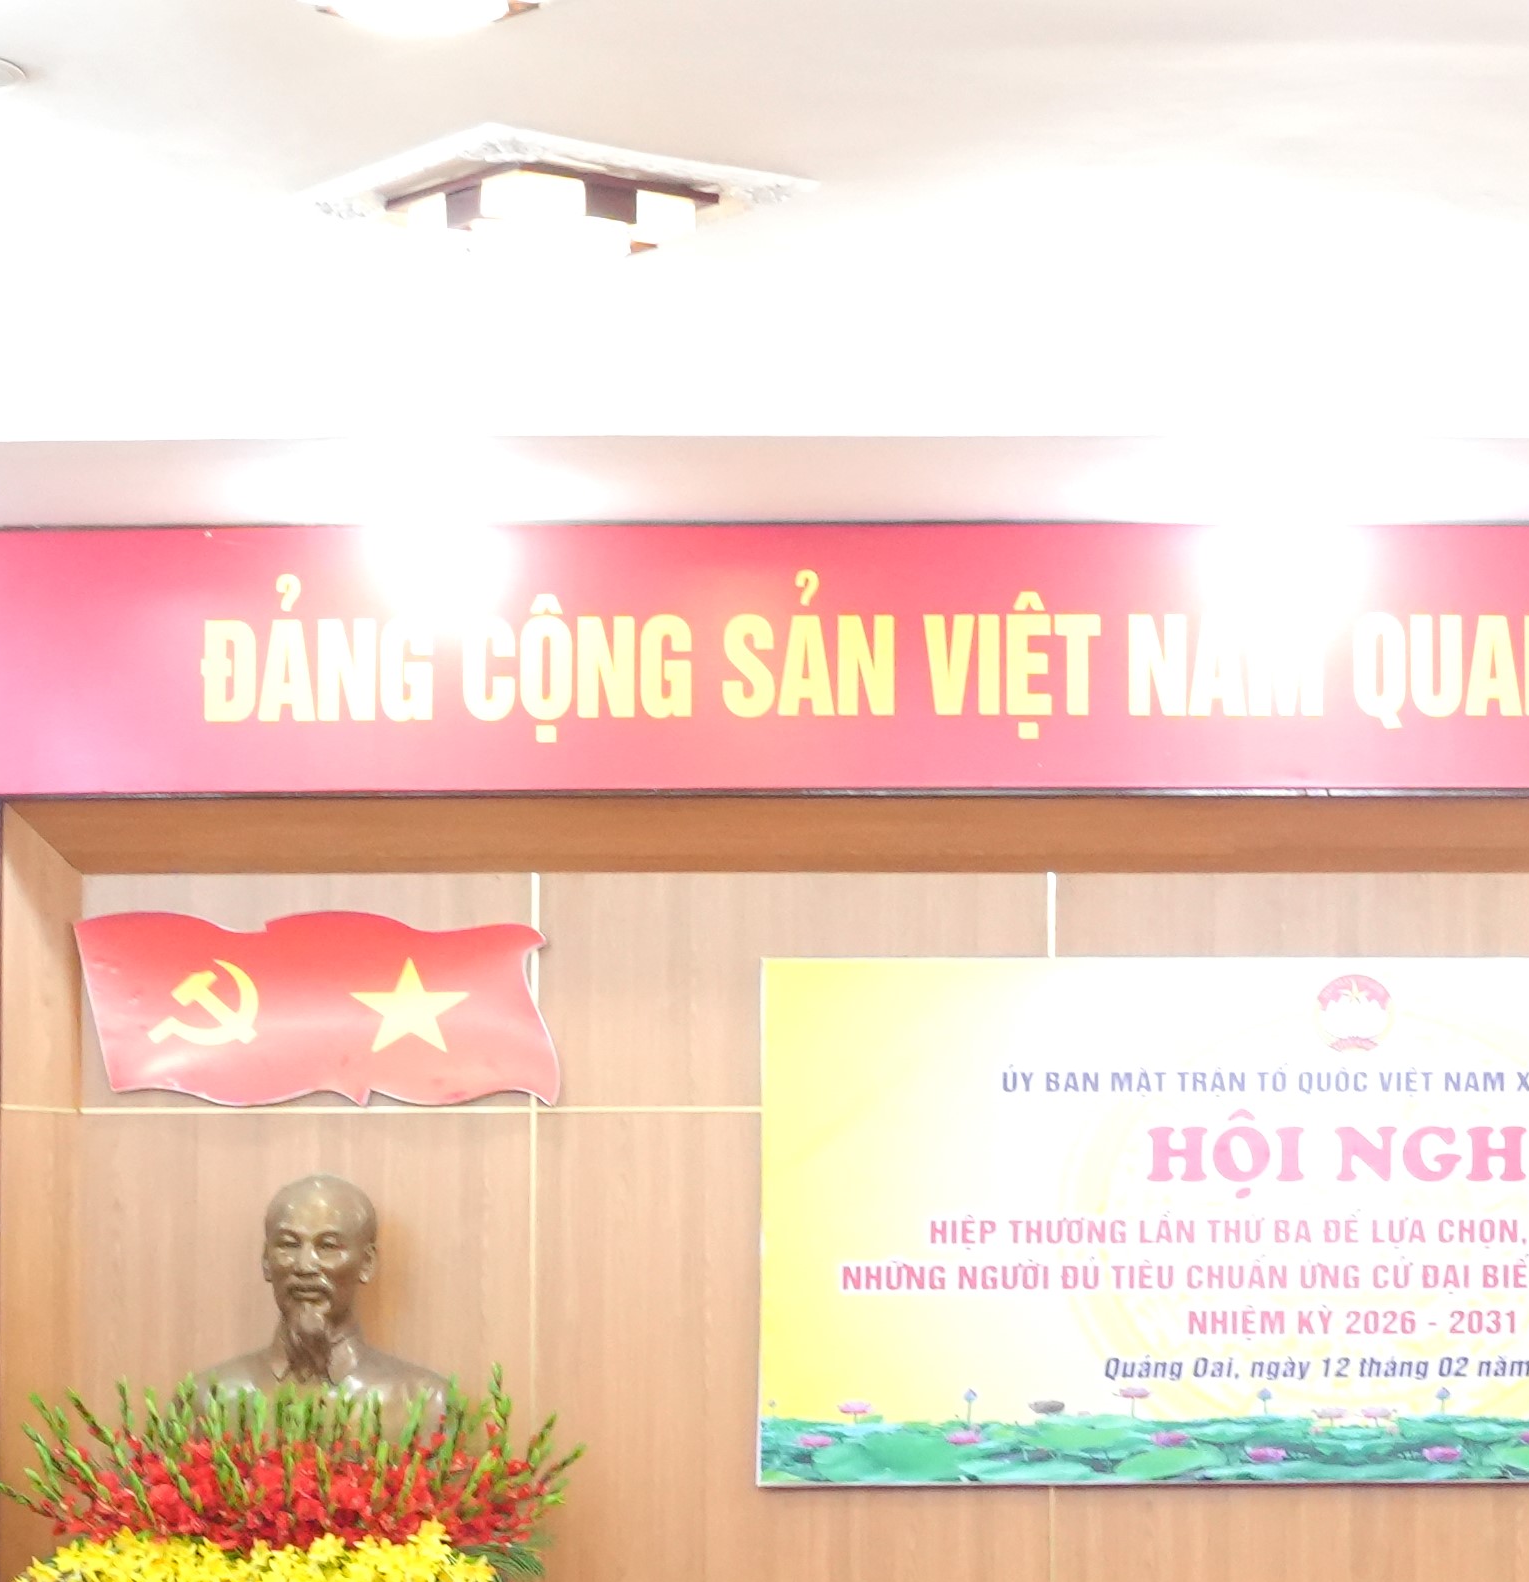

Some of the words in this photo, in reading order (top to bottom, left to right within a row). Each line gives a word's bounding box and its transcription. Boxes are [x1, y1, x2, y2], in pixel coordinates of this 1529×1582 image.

[202, 574, 434, 722] ĐẢNG
[462, 592, 692, 743] CỘNG
[722, 568, 896, 718] SẢN
[925, 590, 1102, 740] VIỆT
[1127, 612, 1325, 717] NAM
[1001, 1063, 1034, 1093] ỦY
[1045, 1071, 1100, 1093] BAN
[1256, 1062, 1288, 1093] TỔ
[1378, 1066, 1434, 1097] VIỆT
[1444, 1071, 1505, 1093] NAM
[1146, 1108, 1305, 1200] HỘI
[929, 1214, 997, 1251] HIỆP
[1008, 1216, 1127, 1245] THƯƠNG
[1138, 1210, 1196, 1244] LẦN
[1273, 1219, 1312, 1244] BA
[1322, 1208, 1361, 1244] ĐỂ
[1371, 1216, 1427, 1250] LỰA
[957, 1258, 1050, 1291] NGƯỜI
[1060, 1256, 1100, 1291] ĐỦ
[1372, 1255, 1414, 1290] CỬ
[1421, 1263, 1470, 1295] ĐẠI
[1187, 1304, 1286, 1341] NHIỆM
[1297, 1304, 1334, 1335] KỲ
[1345, 1309, 1417, 1335] 2026
[1448, 1309, 1516, 1335] 2031
[1103, 1354, 1184, 1382] Quảng
[1249, 1355, 1312, 1381] ngày
[1321, 1356, 1351, 1379] 12
[1358, 1355, 1430, 1381] tháng
[1437, 1355, 1470, 1378] 02
